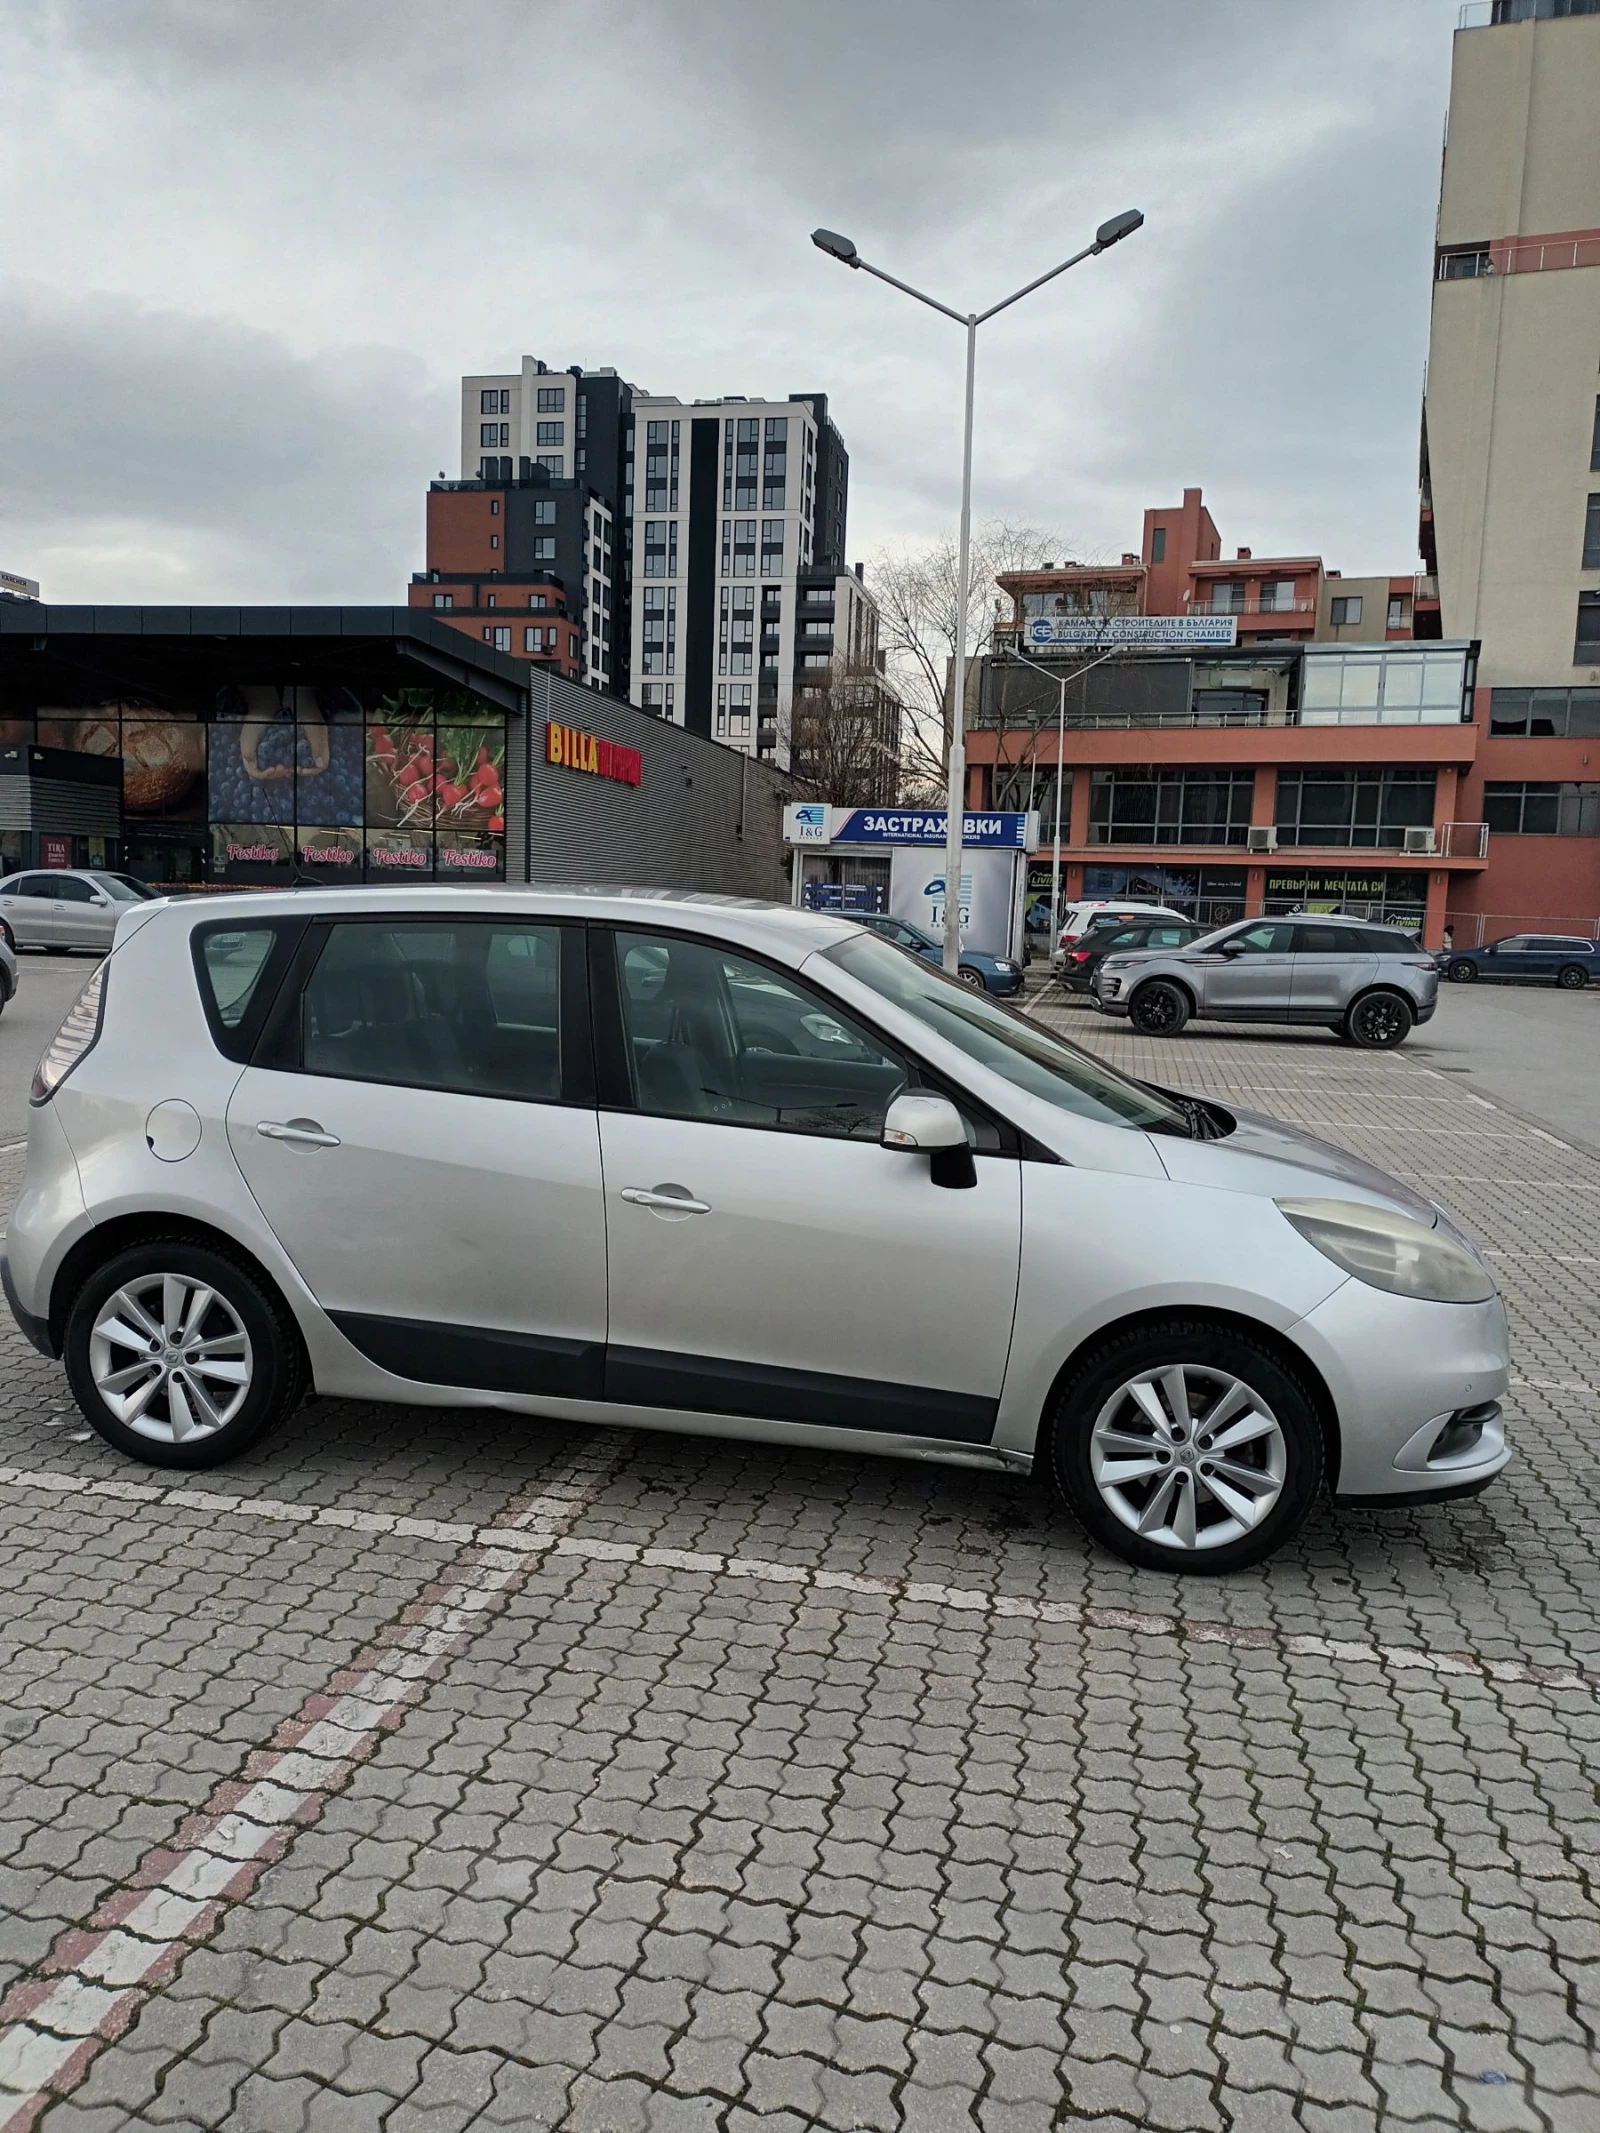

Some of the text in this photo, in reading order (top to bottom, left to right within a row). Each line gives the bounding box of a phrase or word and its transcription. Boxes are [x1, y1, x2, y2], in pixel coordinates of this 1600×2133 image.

[1058, 619, 1096, 628] КАМАРА
[1115, 619, 1176, 627] СТРОИТЕЛИТЕ
[1179, 619, 1184, 627] В
[1187, 619, 1233, 627] БЪЛГАРИЯ
[1058, 630, 1232, 639] BULGARIAN CONSTRUCTION CHAMBER
[550, 721, 599, 775] BILLA
[864, 816, 1002, 835] ЗАСТРАХВКИ
[227, 843, 280, 861] Festiko
[301, 845, 355, 863] Festiko
[373, 847, 428, 866] Festiko
[442, 850, 497, 868] Festiko
[1371, 881, 1384, 892] СИ
[1390, 919, 1421, 928] LIVING
